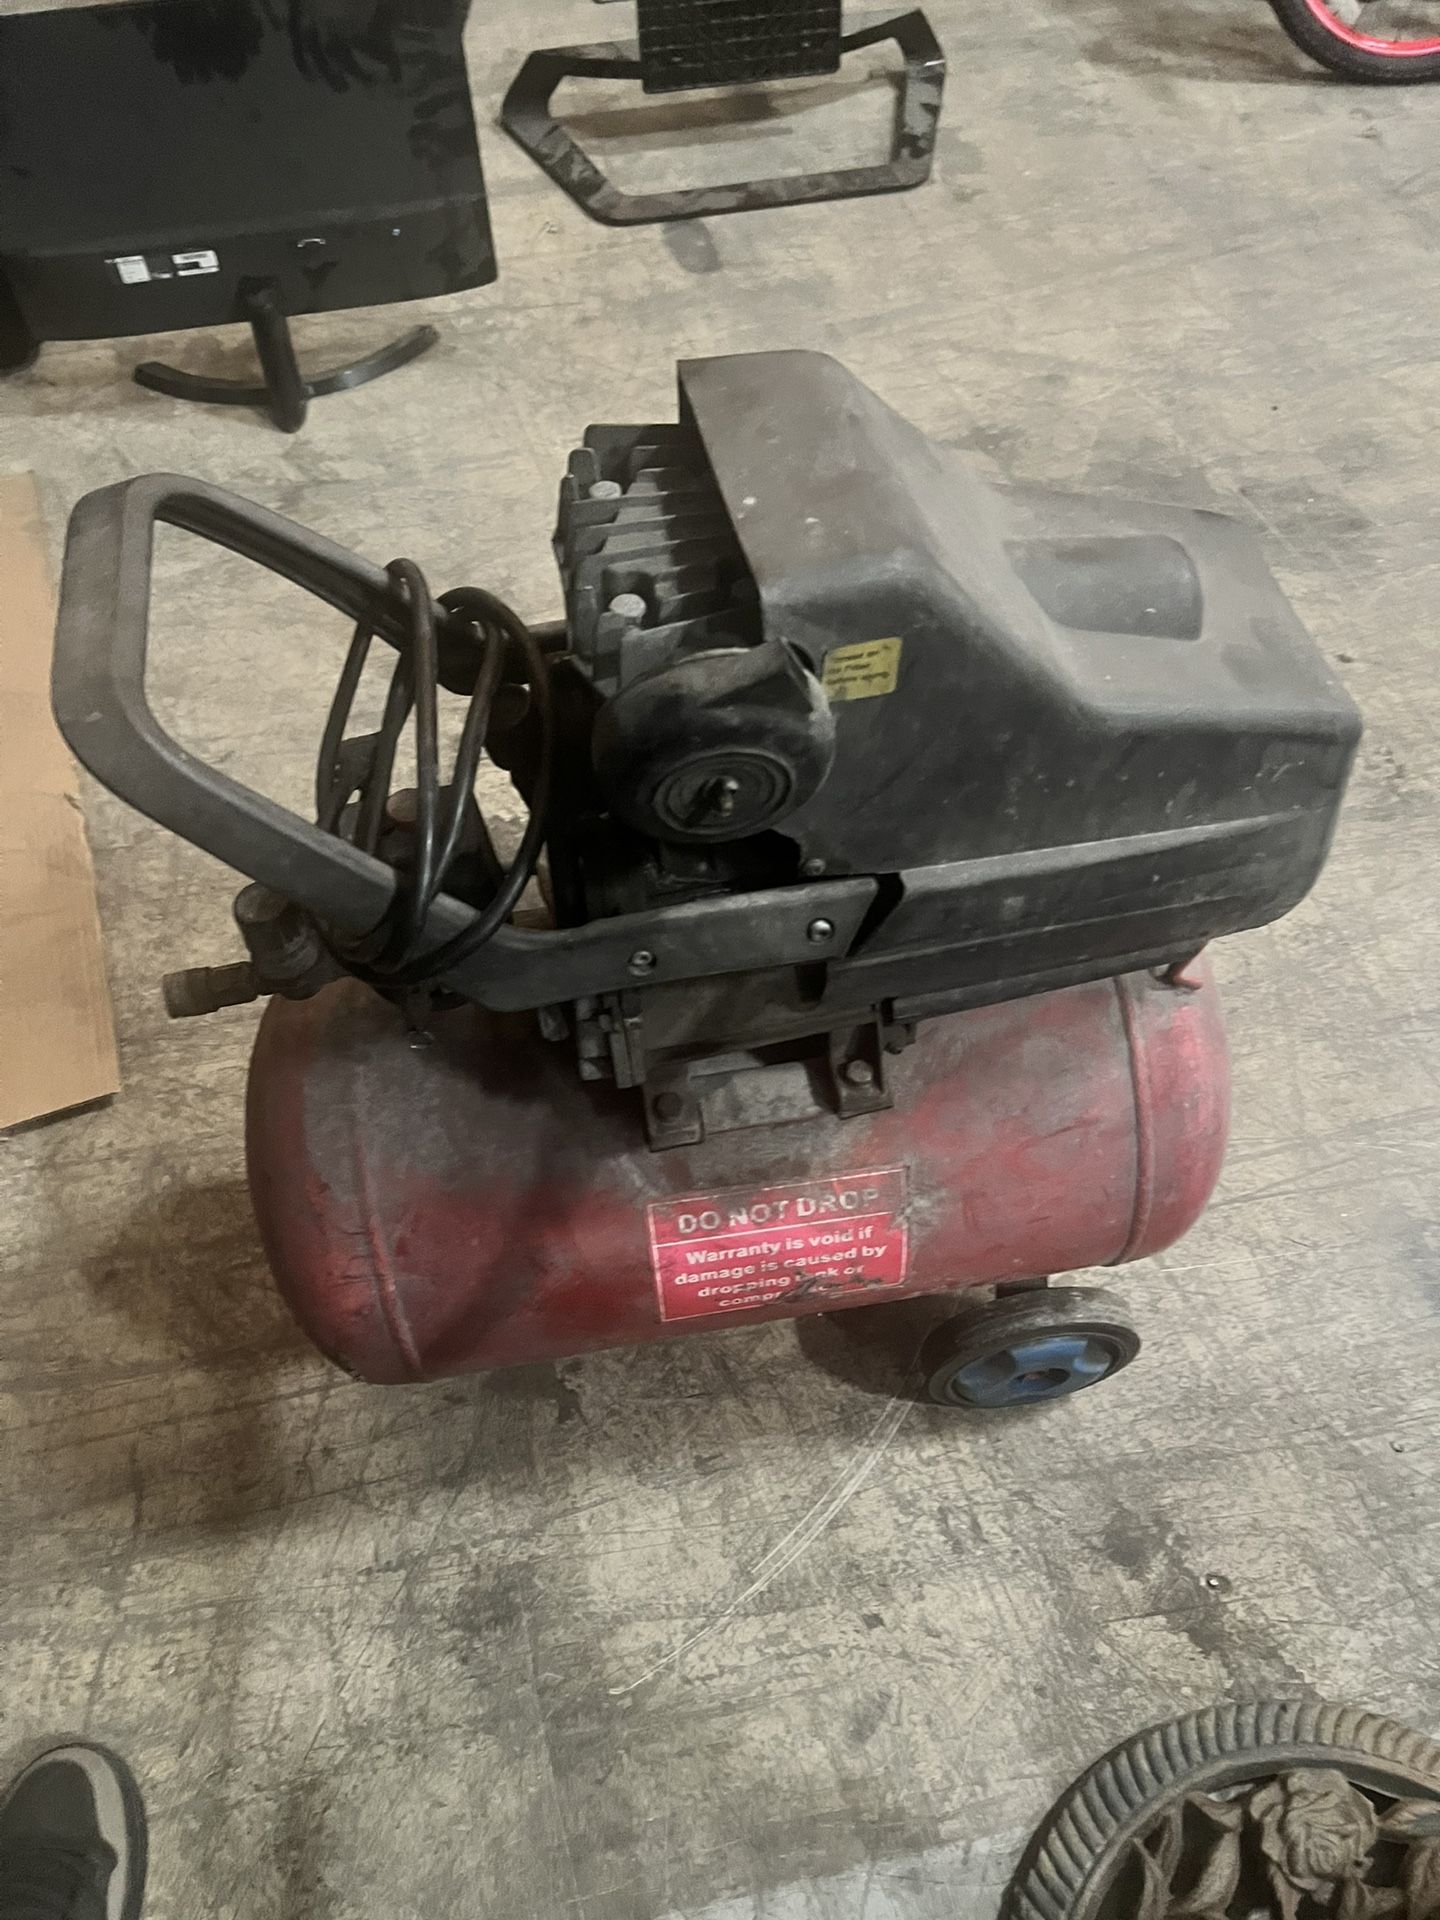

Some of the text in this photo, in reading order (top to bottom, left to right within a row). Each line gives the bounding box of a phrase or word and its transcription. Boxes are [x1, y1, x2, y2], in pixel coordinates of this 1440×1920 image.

[678, 1187, 879, 1234] DO NOT DROP
[674, 1244, 888, 1285] damage is caused by
[685, 1225, 874, 1265] Warranty is void if
[697, 1276, 791, 1297] dropping
[843, 1264, 865, 1276] or
